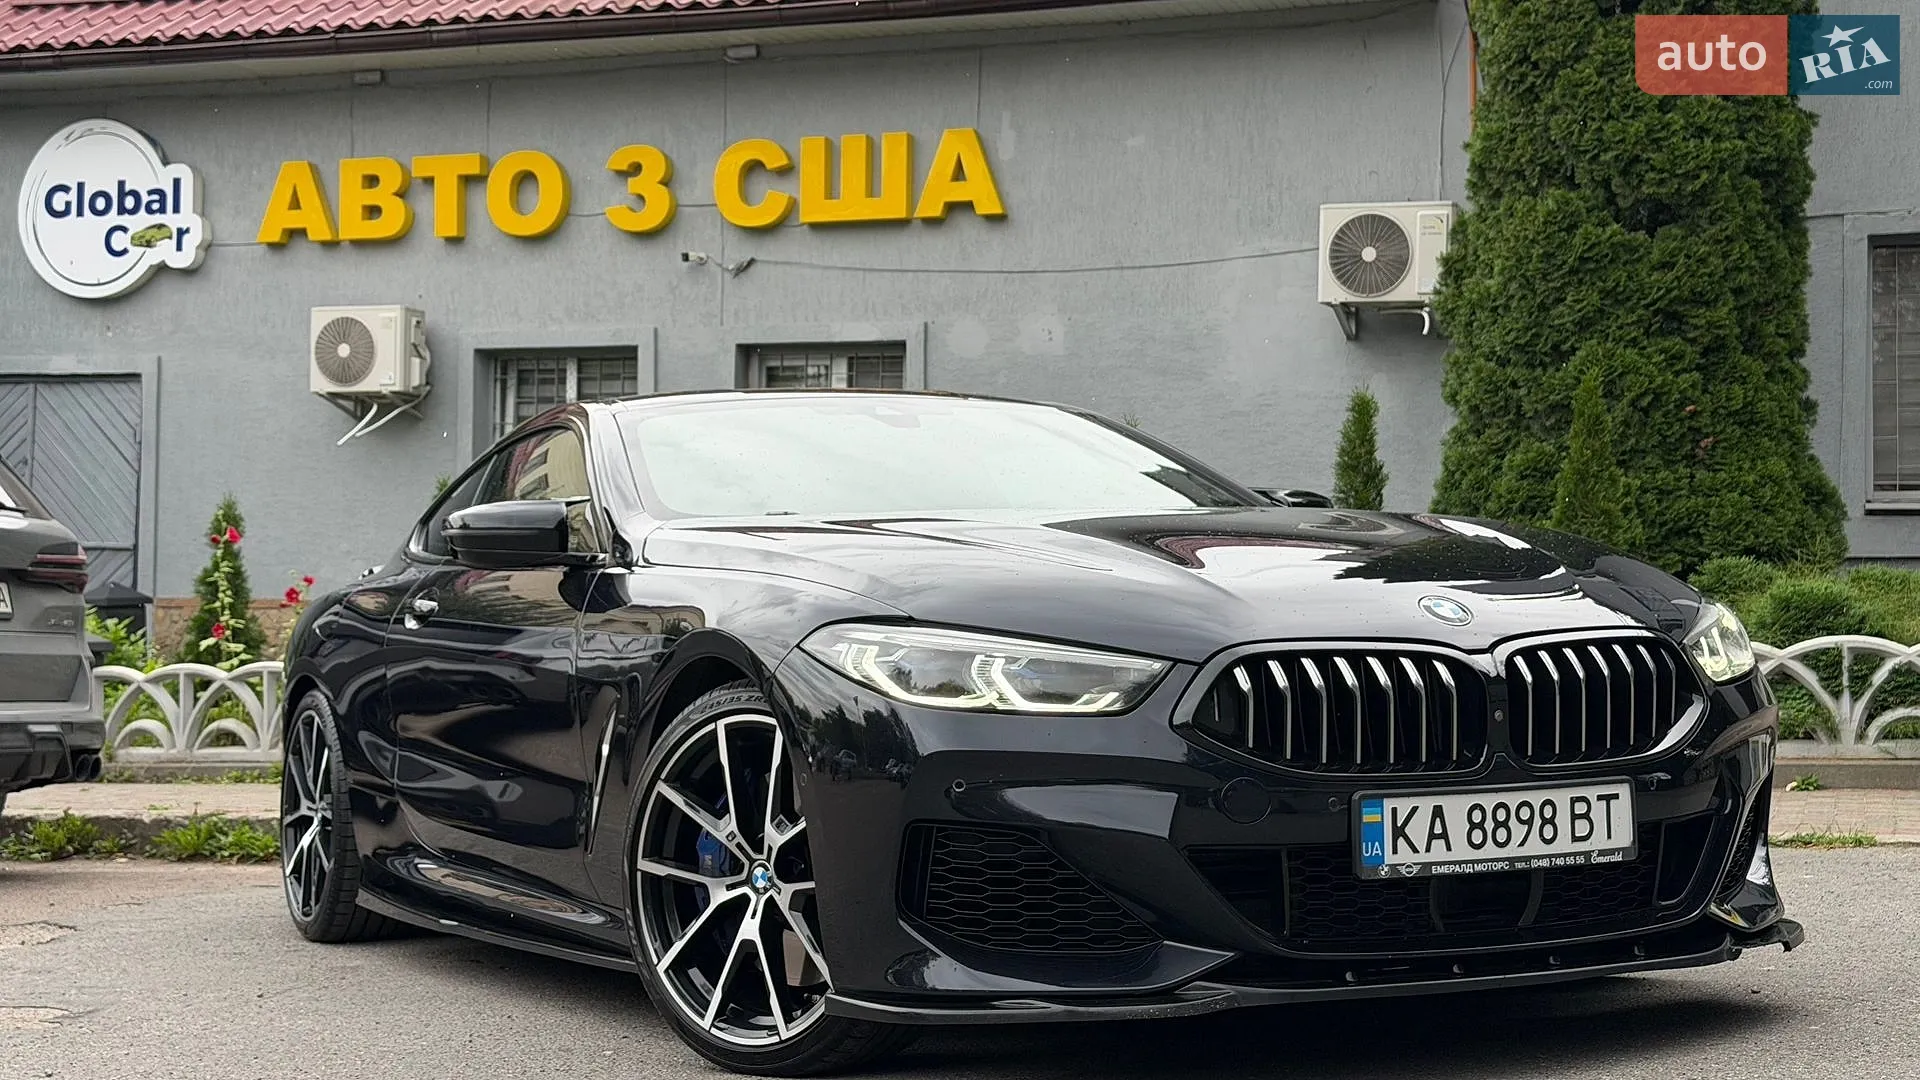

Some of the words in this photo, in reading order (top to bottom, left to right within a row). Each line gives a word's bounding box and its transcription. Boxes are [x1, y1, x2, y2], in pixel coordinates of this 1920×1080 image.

[44, 177, 182, 219] Global
[257, 150, 571, 245] АВТО
[714, 127, 1006, 230] США
[1391, 805, 1452, 855] KA
[1466, 799, 1559, 850] 8898
[1570, 793, 1619, 843] BT
[1362, 841, 1382, 857] UA
[1590, 849, 1623, 864] Emerald
[1431, 864, 1473, 874] ЕМЕРАЛД
[1474, 861, 1509, 872] МОТОРС
[1530, 858, 1550, 869] (048)
[1551, 857, 1564, 866] 740
[1566, 856, 1575, 865] 55
[1576, 855, 1585, 864] 55
